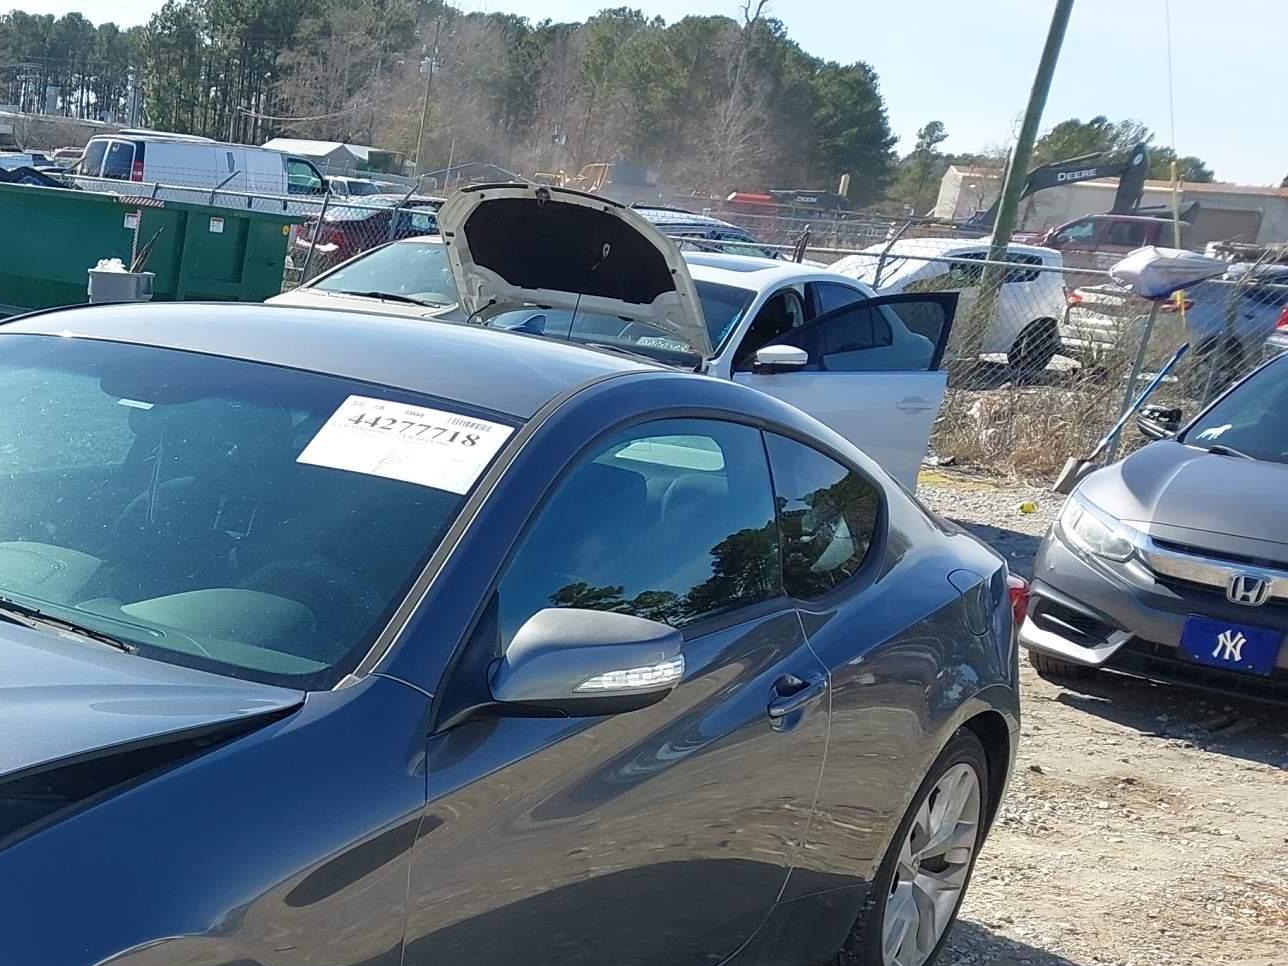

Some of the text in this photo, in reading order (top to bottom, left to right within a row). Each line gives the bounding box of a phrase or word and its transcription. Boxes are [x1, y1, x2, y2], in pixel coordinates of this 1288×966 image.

[1057, 168, 1097, 181] DEERE
[348, 412, 481, 447] 44277718
[1212, 629, 1247, 662] NY
